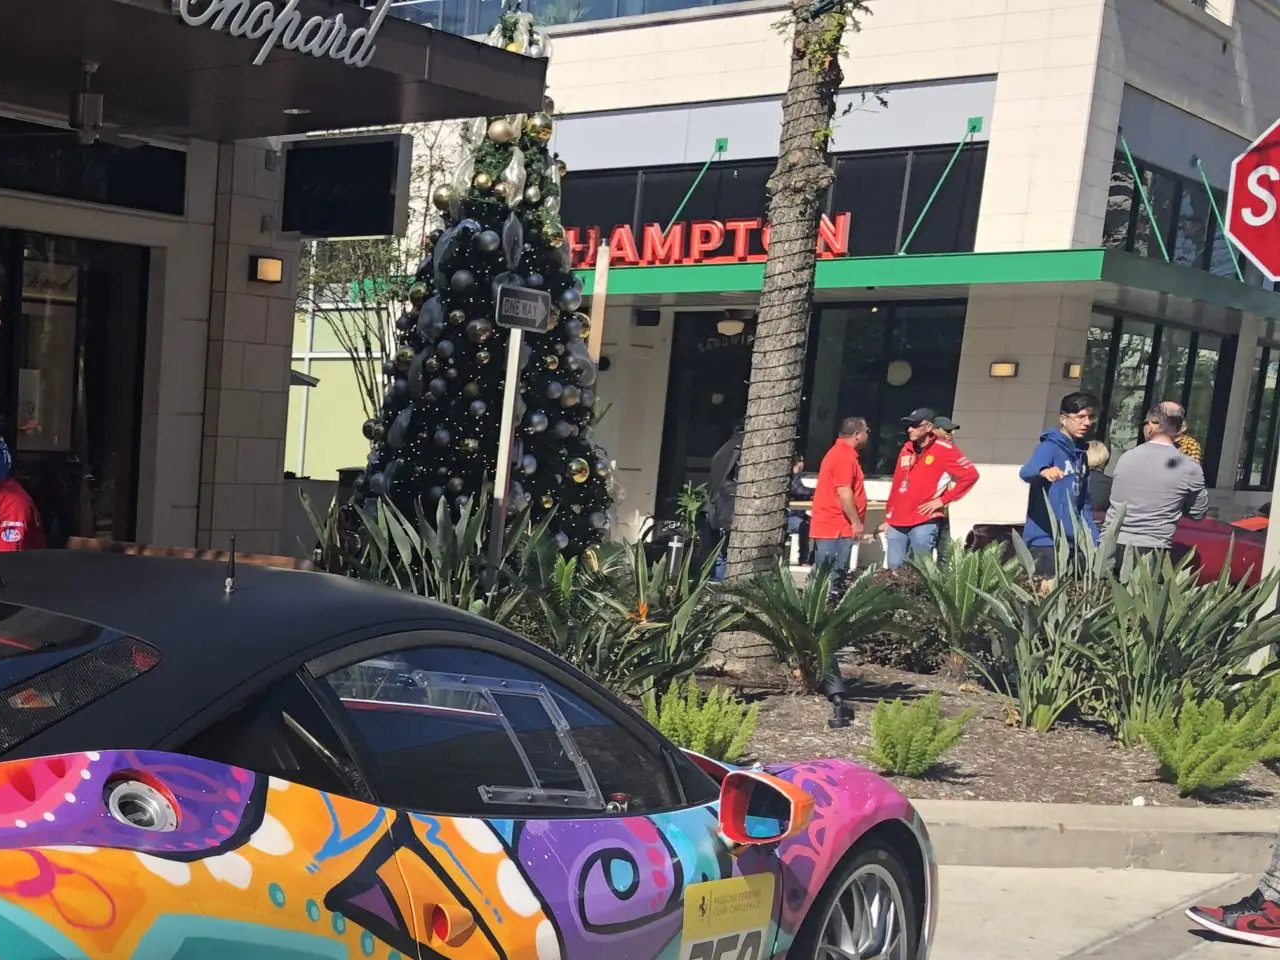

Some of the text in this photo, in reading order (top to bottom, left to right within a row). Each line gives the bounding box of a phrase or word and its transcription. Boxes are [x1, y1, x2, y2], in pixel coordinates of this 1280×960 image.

[179, 0, 391, 67] opard
[566, 211, 852, 268] HAMPTN
[503, 298, 539, 319] ONE WAY
